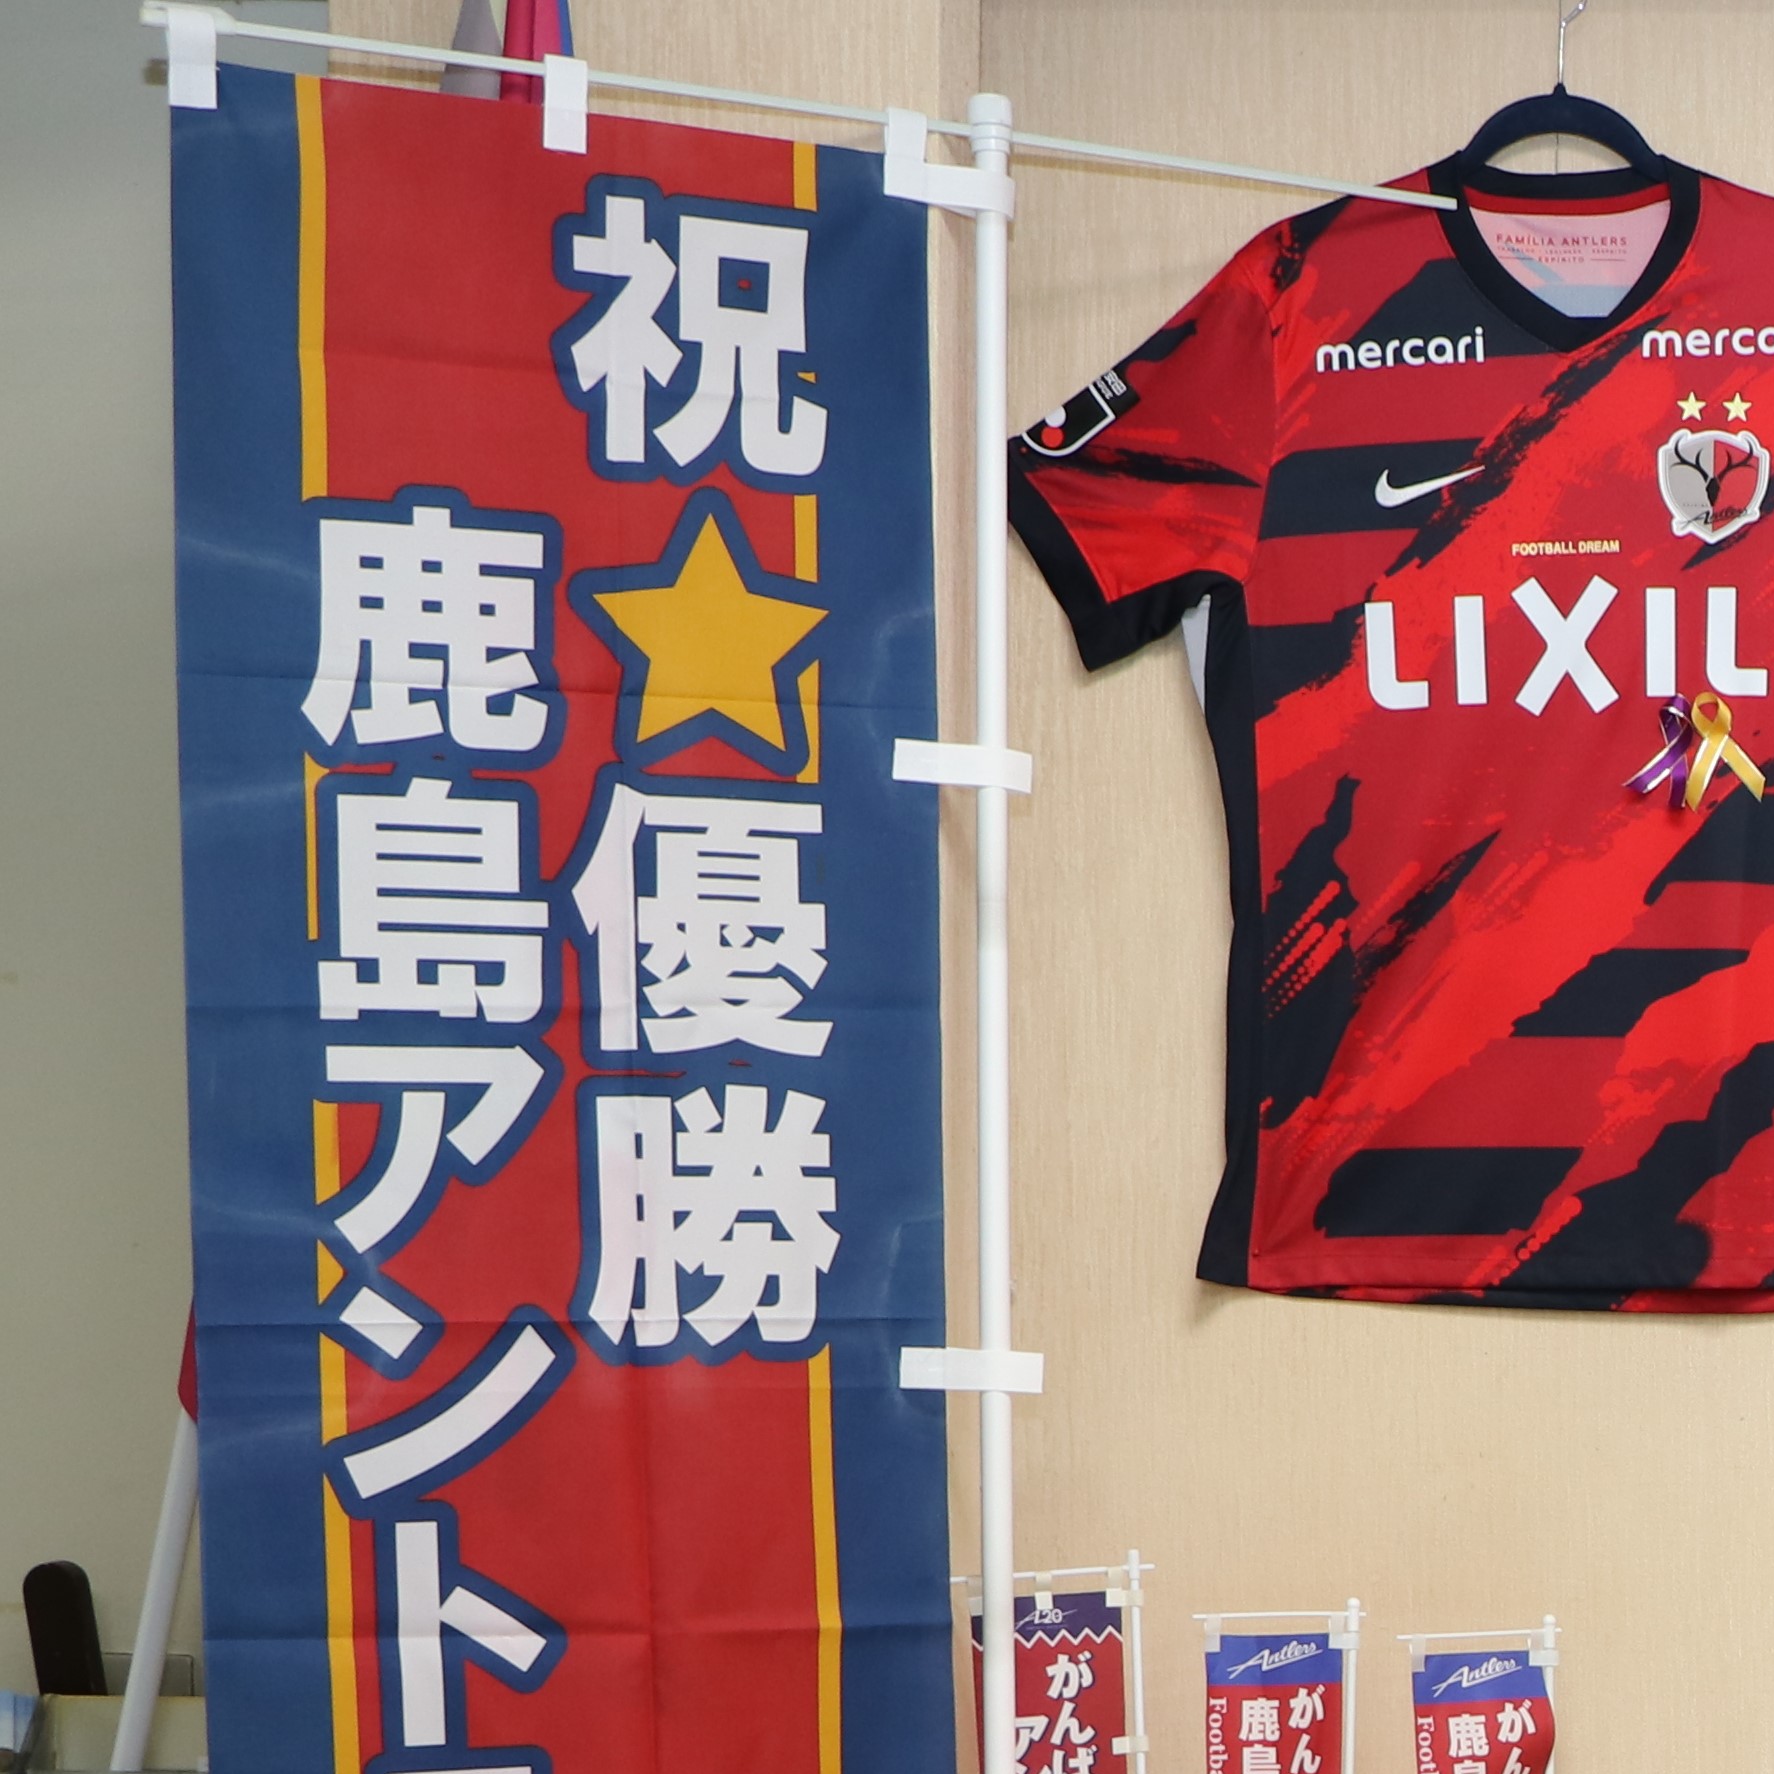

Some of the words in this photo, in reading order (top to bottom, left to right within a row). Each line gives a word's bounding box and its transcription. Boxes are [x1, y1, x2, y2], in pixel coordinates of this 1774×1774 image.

[1496, 233, 1556, 246] FAMÍLIA
[1561, 235, 1628, 247] ANTLERS
[1316, 327, 1486, 372] mercari
[1511, 543, 1575, 556] FOOTBALL
[1579, 541, 1621, 554] DREAM
[1364, 575, 1770, 717] LIXIL
[1227, 1639, 1322, 1679] Antlers
[1432, 1656, 1523, 1698] Antlers
